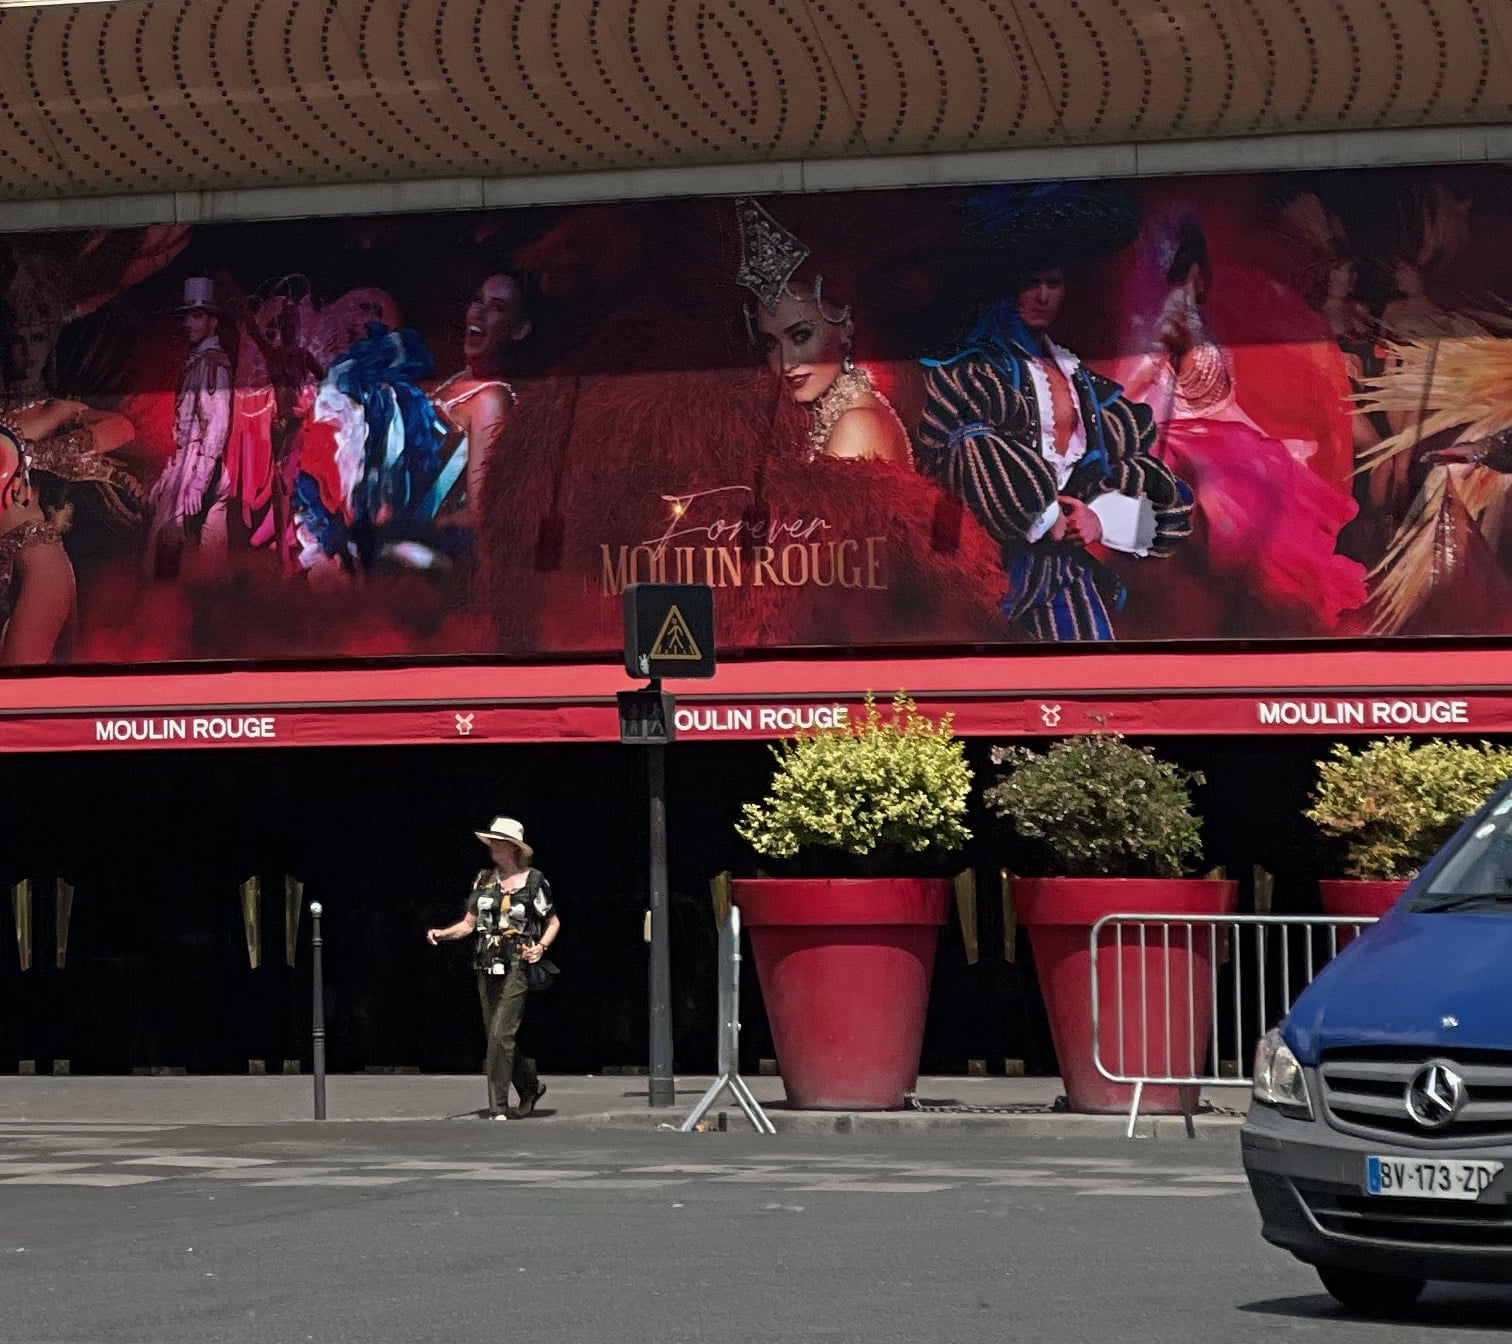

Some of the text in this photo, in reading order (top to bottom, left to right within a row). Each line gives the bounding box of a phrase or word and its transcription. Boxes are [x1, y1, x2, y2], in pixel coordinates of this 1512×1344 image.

[641, 485, 832, 562] Forever
[753, 536, 889, 591] ROUGE
[674, 707, 849, 731] OULIN ROUGE
[1259, 701, 1469, 724] MOULIN ROUGE
[95, 717, 276, 740] MOULIN ROUGE
